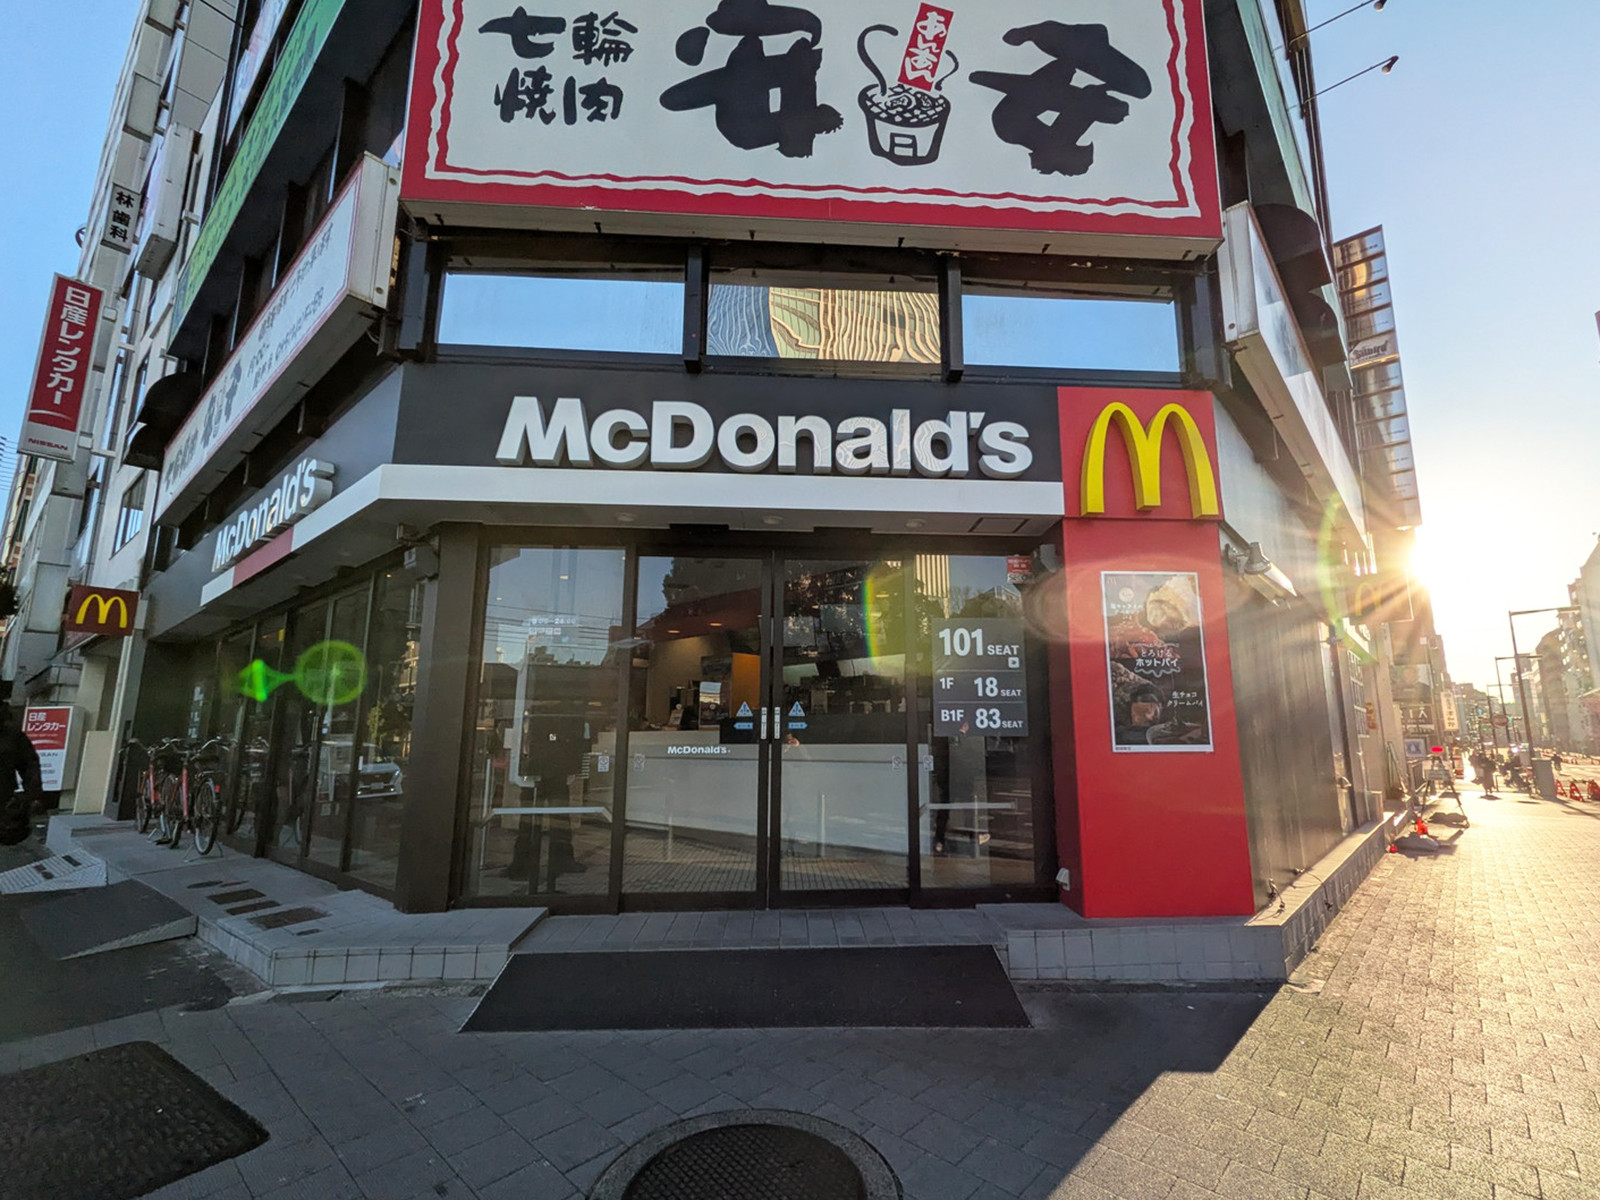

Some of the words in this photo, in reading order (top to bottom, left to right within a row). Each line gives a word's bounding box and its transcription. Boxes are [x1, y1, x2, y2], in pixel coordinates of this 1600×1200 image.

[478, 7, 638, 67] 七輪
[496, 66, 622, 125] 焼肉
[659, 0, 844, 157] 安
[109, 190, 134, 243] 林歯科
[46, 286, 91, 405] 日産レンタカー
[28, 437, 68, 451] NISSAN
[496, 395, 1032, 478] McDonald's
[212, 458, 334, 570] McDonald's
[939, 628, 984, 656] 101
[987, 645, 1019, 656] SEAT
[939, 677, 954, 690] 1F
[974, 677, 998, 698] 18
[1001, 689, 1021, 697] SEAT
[27, 722, 66, 731] レンタカー
[28, 712, 46, 721] 日産
[941, 709, 965, 722] B1F
[975, 709, 1001, 729] 83
[667, 746, 727, 754] McDonald's
